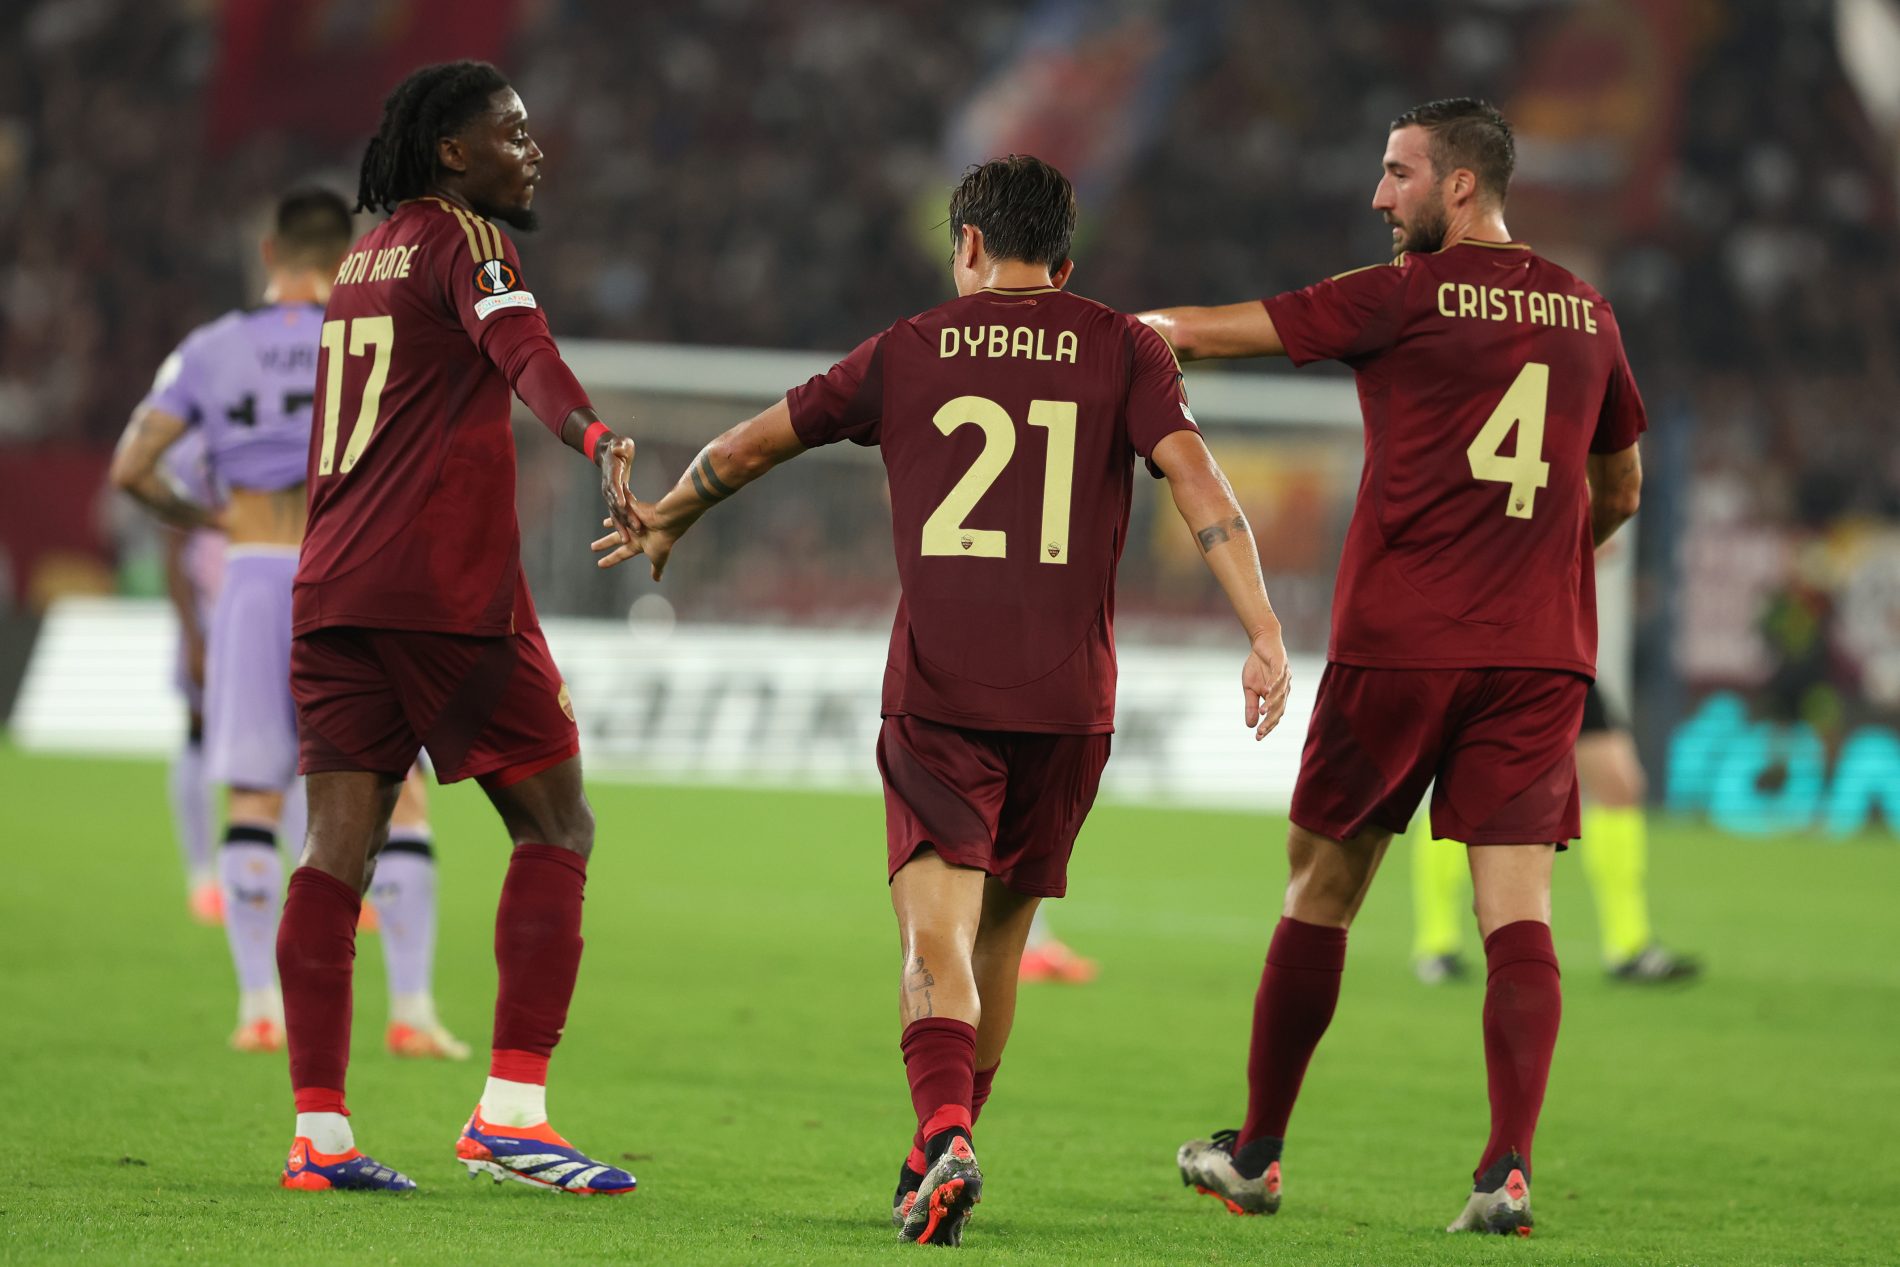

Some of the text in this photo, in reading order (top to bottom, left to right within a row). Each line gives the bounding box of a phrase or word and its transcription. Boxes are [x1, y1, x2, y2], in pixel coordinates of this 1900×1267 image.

[940, 325, 1078, 364] DYBALA
[1437, 282, 1598, 335] CRISTANTE
[318, 315, 394, 476] 17
[1466, 361, 1550, 519] 4
[921, 395, 1078, 565] 21
